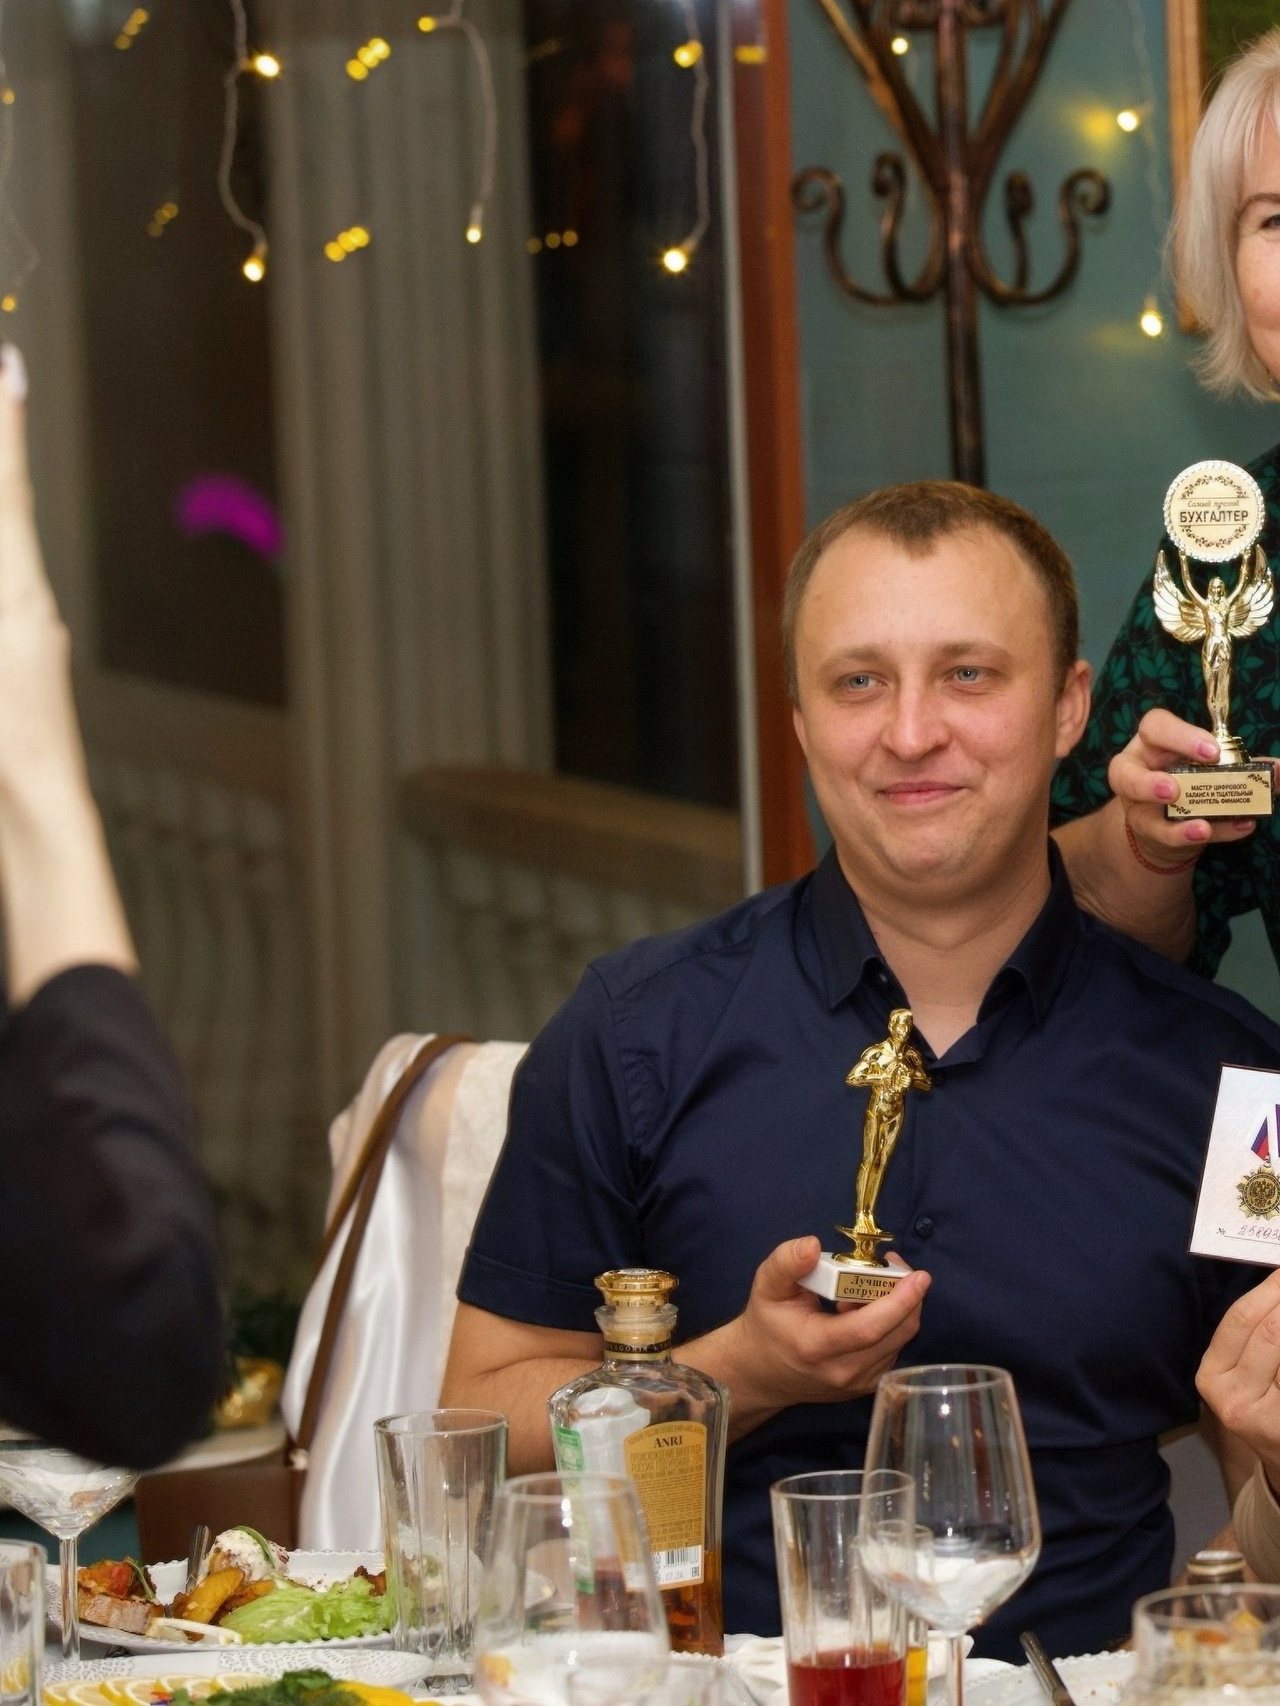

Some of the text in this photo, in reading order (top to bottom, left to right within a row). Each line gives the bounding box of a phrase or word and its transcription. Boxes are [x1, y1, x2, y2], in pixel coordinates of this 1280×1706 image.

[1188, 500, 1212, 508] Самый
[1180, 510, 1249, 523] БУХГАЛТЕР
[1216, 789, 1253, 797] ТЩАТЕЛЬНЫЙ
[850, 1275, 896, 1288] Лучшем
[653, 1435, 684, 1449] ANRI
